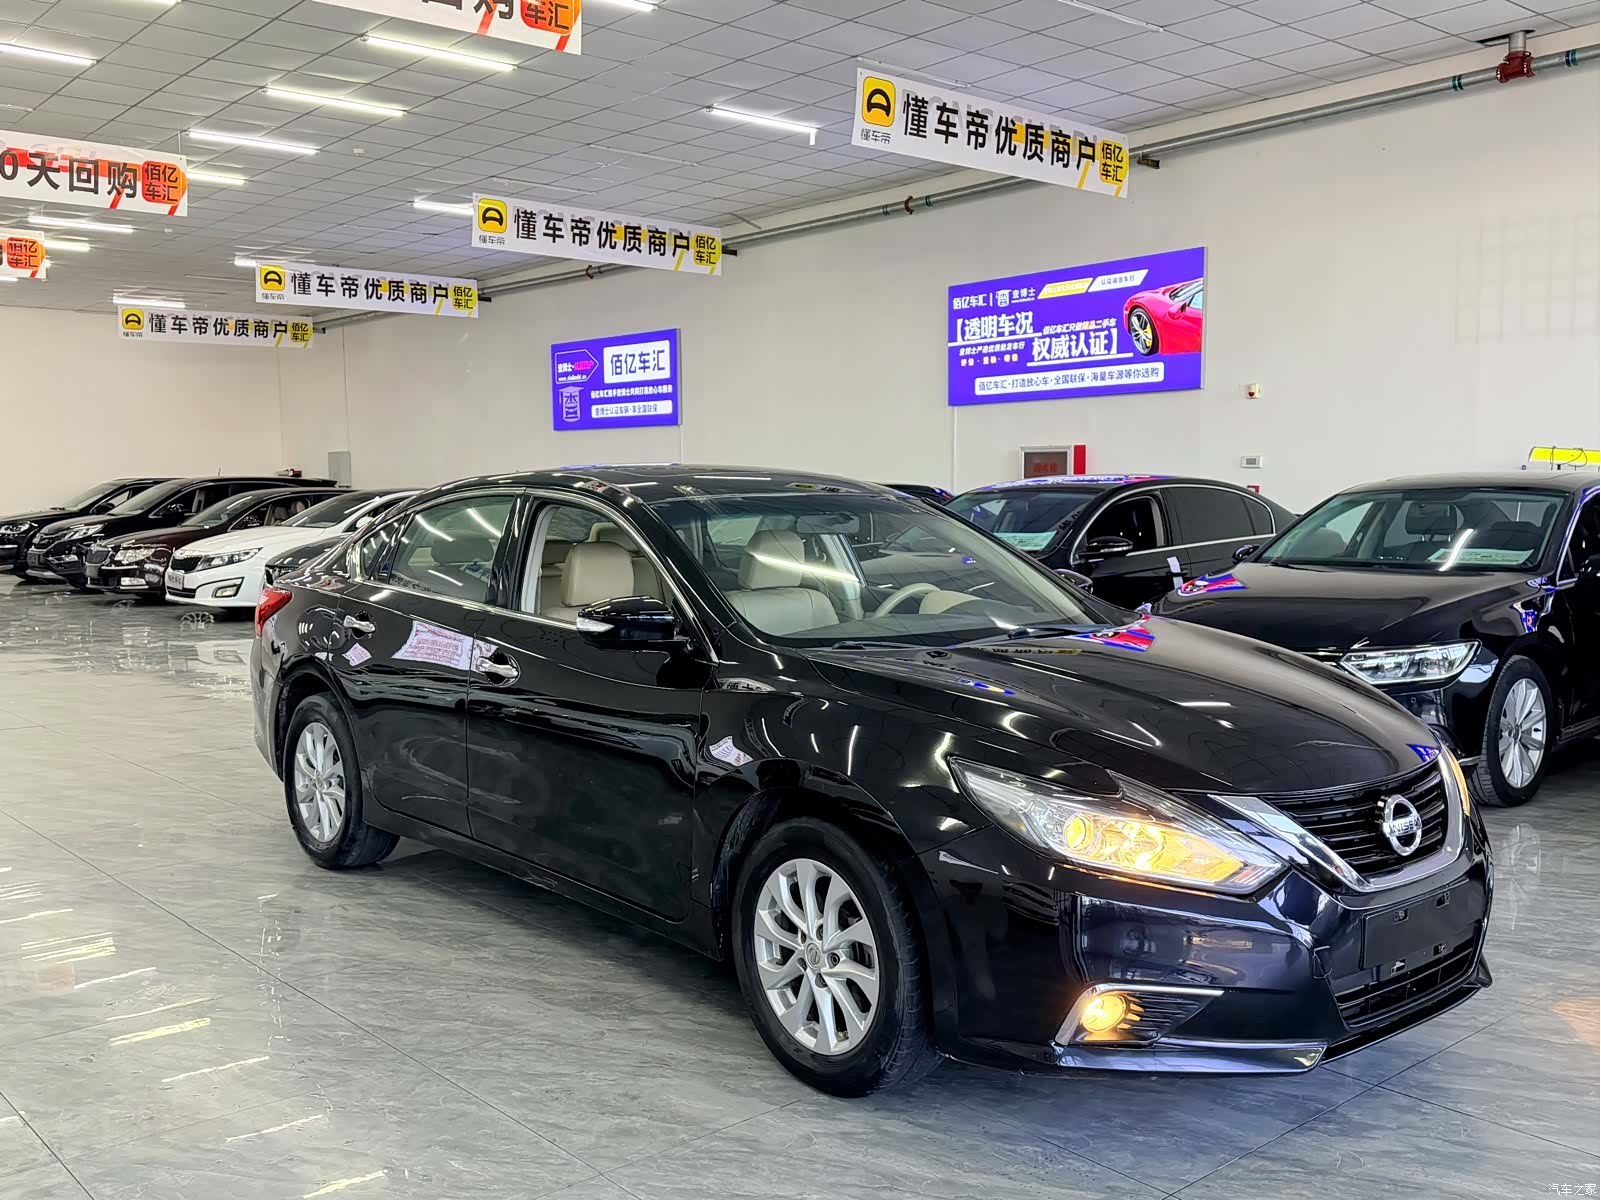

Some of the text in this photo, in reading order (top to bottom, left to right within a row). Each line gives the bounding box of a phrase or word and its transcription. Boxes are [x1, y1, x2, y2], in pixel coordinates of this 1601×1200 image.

[860, 128, 891, 145] 懂车帝
[902, 93, 1096, 171] 懂车帝优质商户
[1101, 142, 1123, 163] 佰亿
[0, 149, 137, 199] 0天回购
[145, 163, 179, 183] 佰亿
[1101, 162, 1123, 183] 车汇
[145, 183, 179, 202] 车汇
[478, 234, 505, 246] 懂车帝
[514, 208, 690, 258] 懂车帝优质商户
[9, 239, 38, 253] 佰亿
[695, 235, 716, 250] 佰亿
[9, 254, 38, 268] 车汇
[695, 250, 716, 265] 车汇
[291, 271, 448, 304] 懂车帝优质商户
[453, 286, 473, 298] 佰亿
[453, 297, 473, 309] 车汇
[953, 293, 987, 310] 佰亿车汇
[149, 312, 287, 339] 懂车帝优质商户
[291, 322, 309, 332] 佰亿
[291, 332, 309, 342] 车汇
[610, 349, 665, 376] 佰亿车汇
